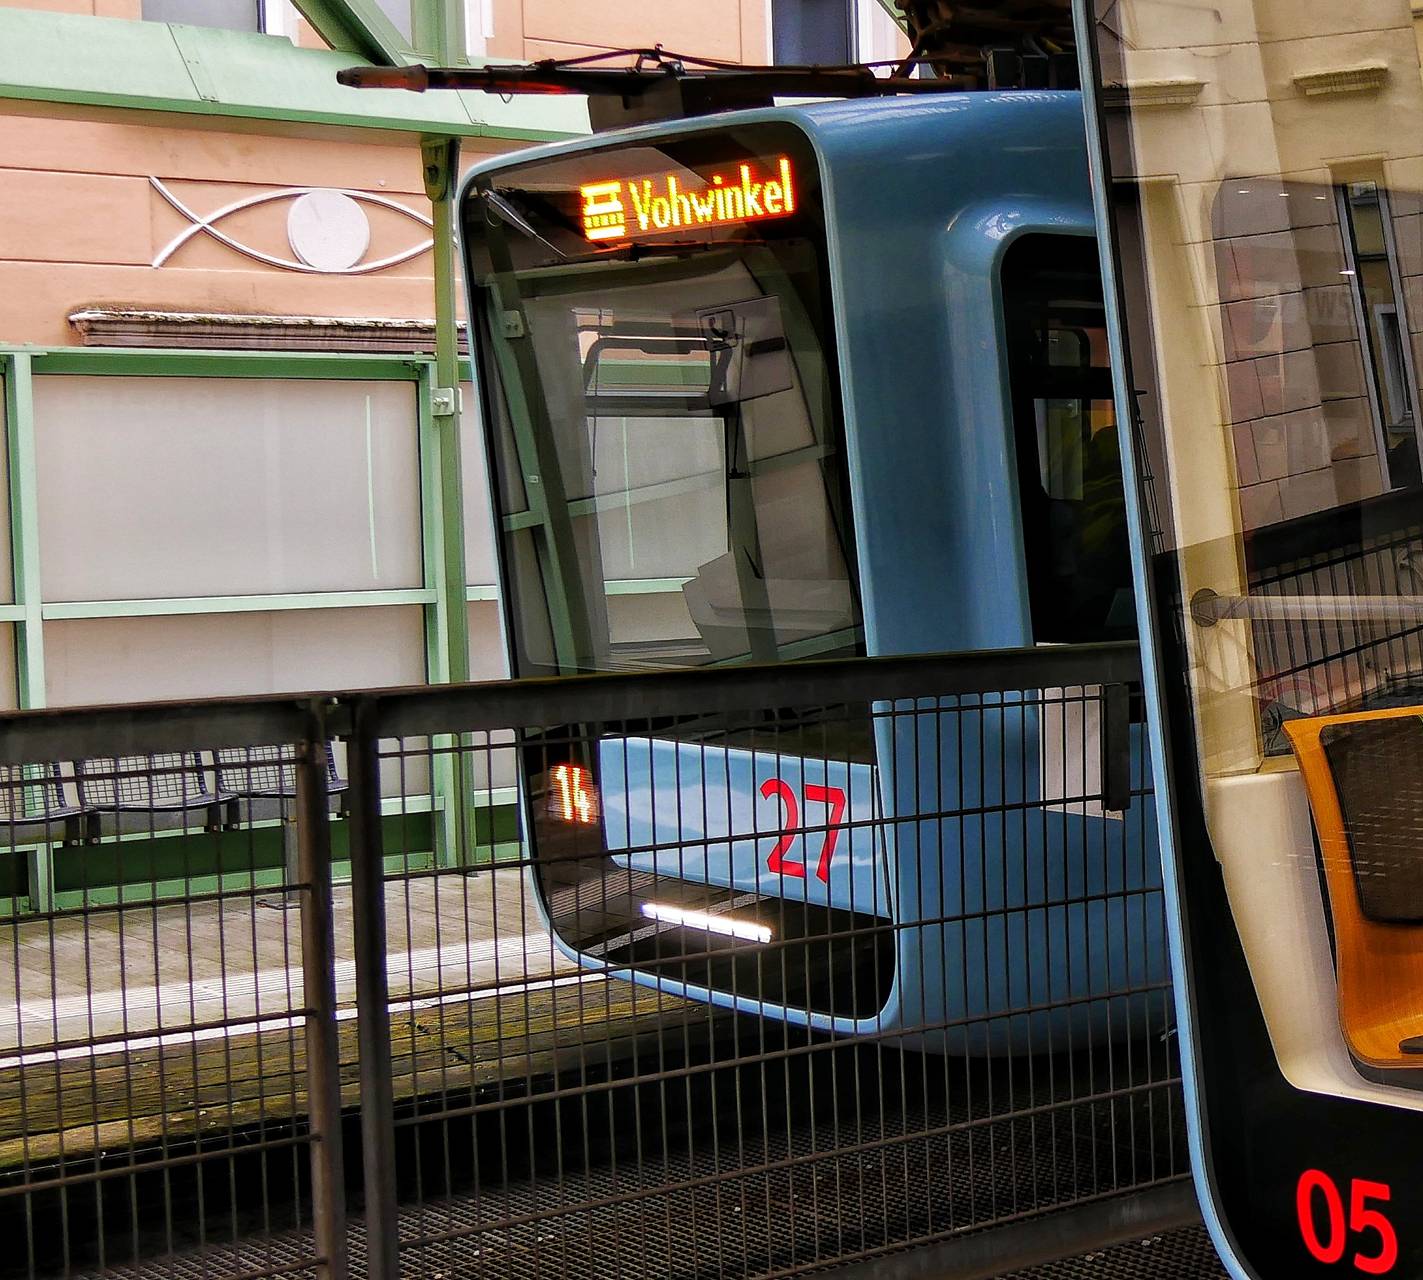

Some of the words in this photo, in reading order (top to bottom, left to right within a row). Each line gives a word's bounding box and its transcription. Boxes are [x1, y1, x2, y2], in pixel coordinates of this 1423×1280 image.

[628, 158, 793, 231] Vohwinkel
[556, 766, 590, 823] 14
[760, 778, 846, 884] 27
[1296, 1169, 1398, 1274] 05
